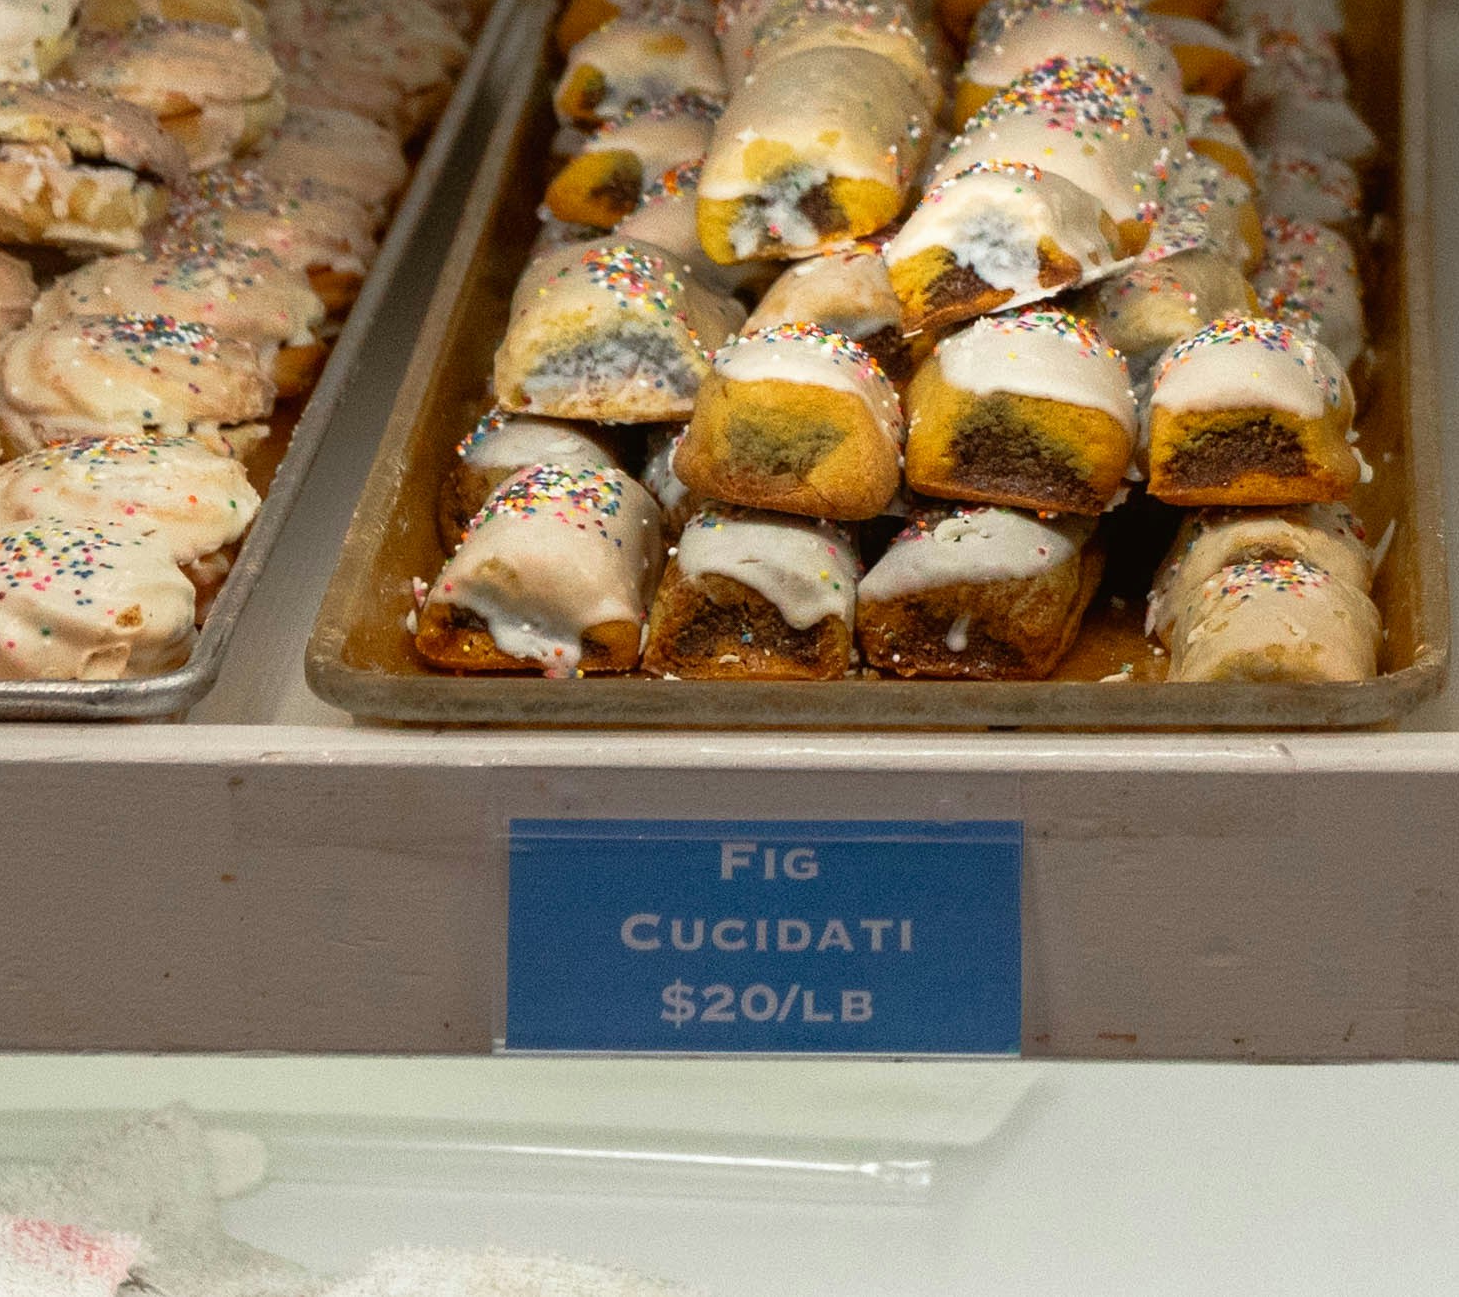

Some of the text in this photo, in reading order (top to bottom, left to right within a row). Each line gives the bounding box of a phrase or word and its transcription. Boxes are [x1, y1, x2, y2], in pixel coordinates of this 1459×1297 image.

[720, 836, 819, 881] FIG
[620, 912, 913, 952] CUCIDATI
[661, 979, 874, 1028] $20/LB
